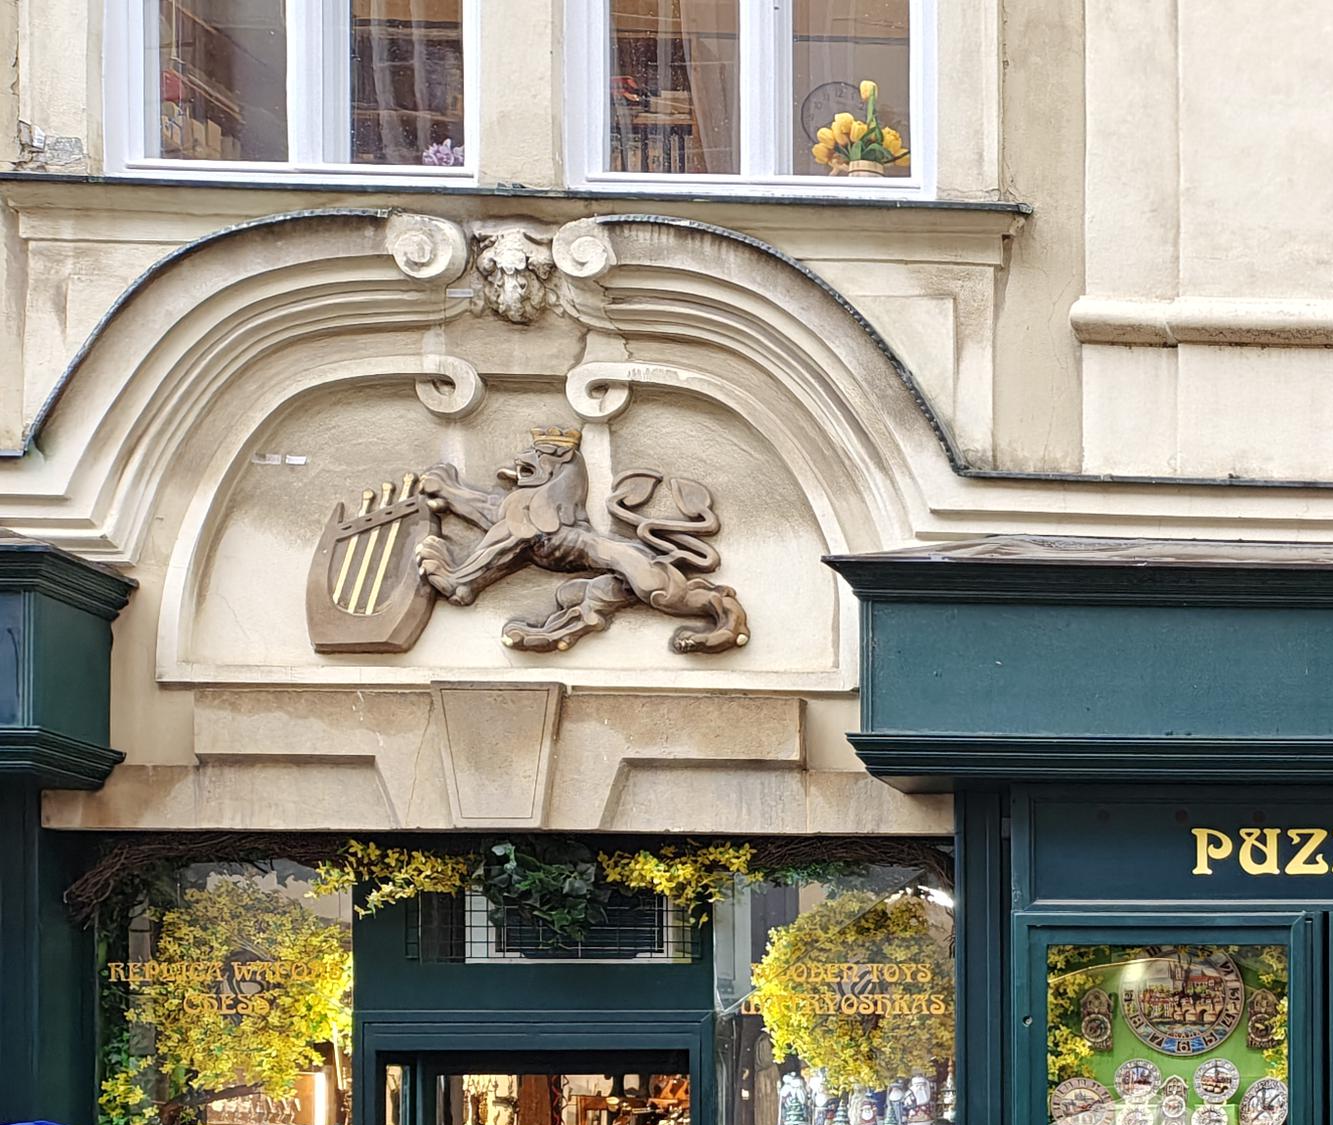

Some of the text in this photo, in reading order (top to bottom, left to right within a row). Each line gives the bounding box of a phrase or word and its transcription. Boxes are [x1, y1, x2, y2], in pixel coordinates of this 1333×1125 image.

[107, 961, 225, 982] REPLICA
[751, 963, 933, 982] ODEN TOYS
[740, 994, 946, 1018] MRYOSHKAS
